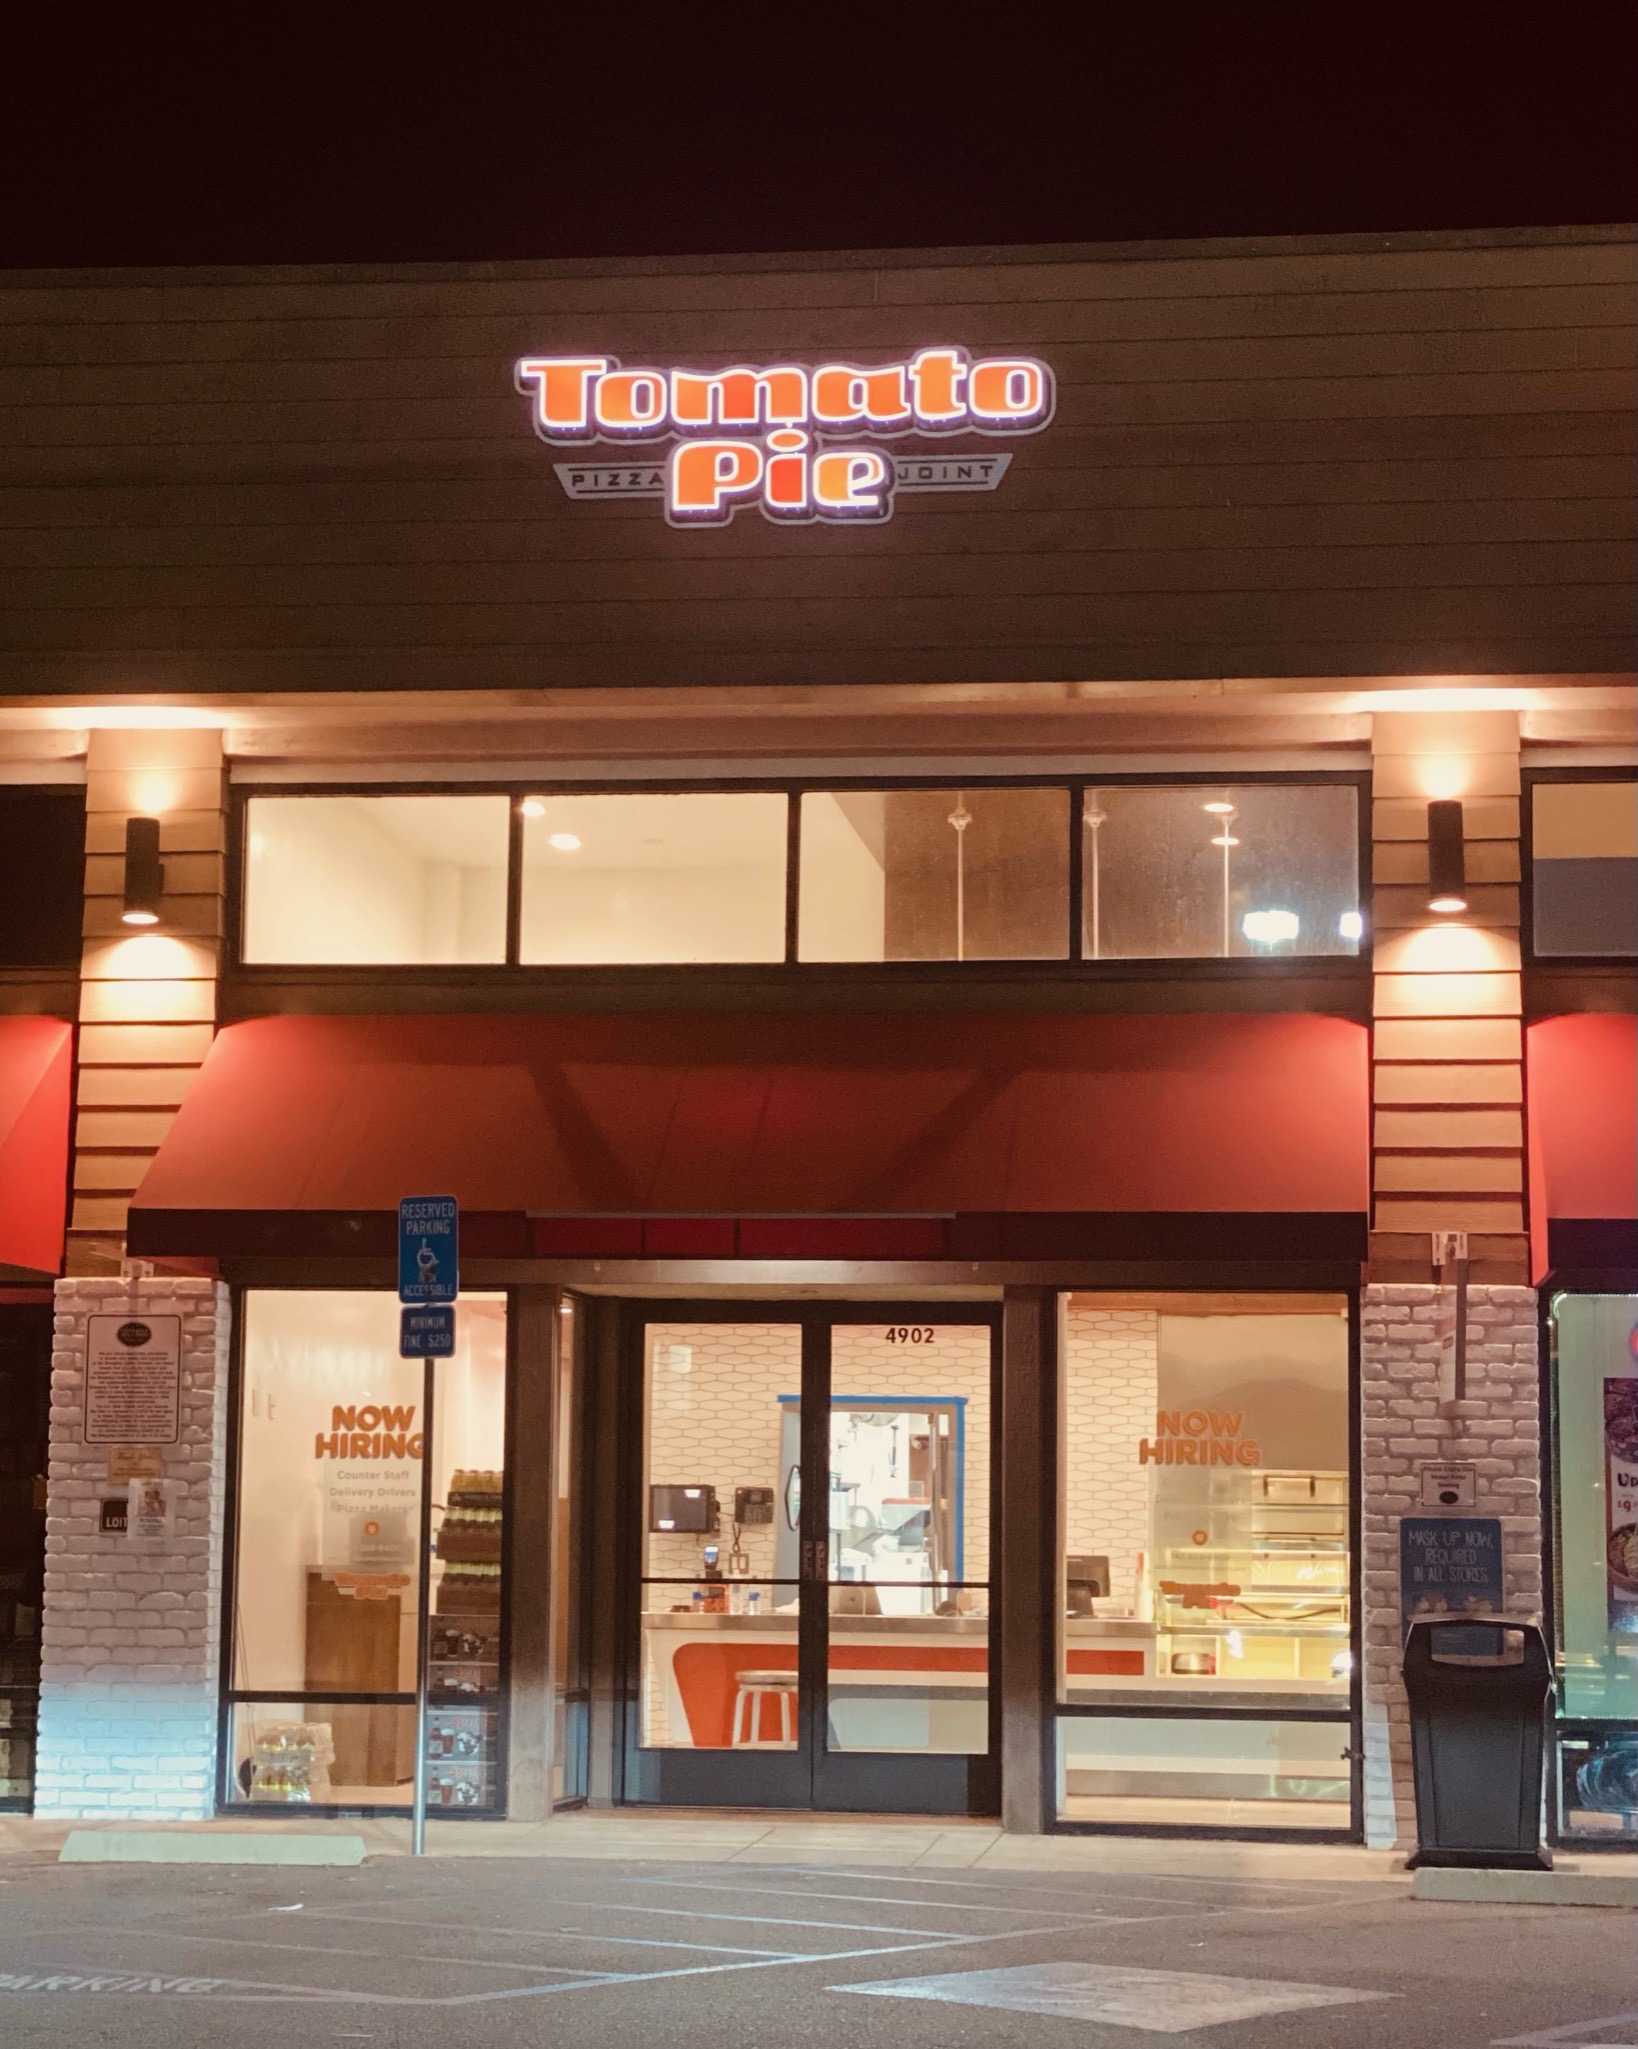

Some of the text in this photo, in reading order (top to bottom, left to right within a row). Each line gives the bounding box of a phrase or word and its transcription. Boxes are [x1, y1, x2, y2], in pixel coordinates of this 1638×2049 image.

[519, 349, 1046, 430] Tomato
[672, 426, 882, 512] Pie
[897, 465, 993, 479] JOINT
[572, 472, 664, 487] PIZZA
[401, 1203, 455, 1219] RESERVED
[406, 1219, 450, 1235] PARKING
[403, 1283, 453, 1297] ACCESSIBLE
[410, 1315, 446, 1330] MINIMUM
[404, 1333, 450, 1348] FINE $250
[885, 1327, 935, 1344] 4902
[332, 1405, 416, 1432] NOW
[1157, 1410, 1243, 1437] NOW
[315, 1432, 424, 1460] HIRING
[1139, 1438, 1260, 1466] HIRING
[337, 1470, 410, 1480] Counter Staff
[330, 1487, 416, 1498] Delivery Drivers
[1408, 1531, 1438, 1547] MASK
[1442, 1531, 1460, 1547] UP
[1425, 1549, 1477, 1565] REQUIRED
[1413, 1566, 1424, 1582] IN
[1427, 1566, 1444, 1582] ALL
